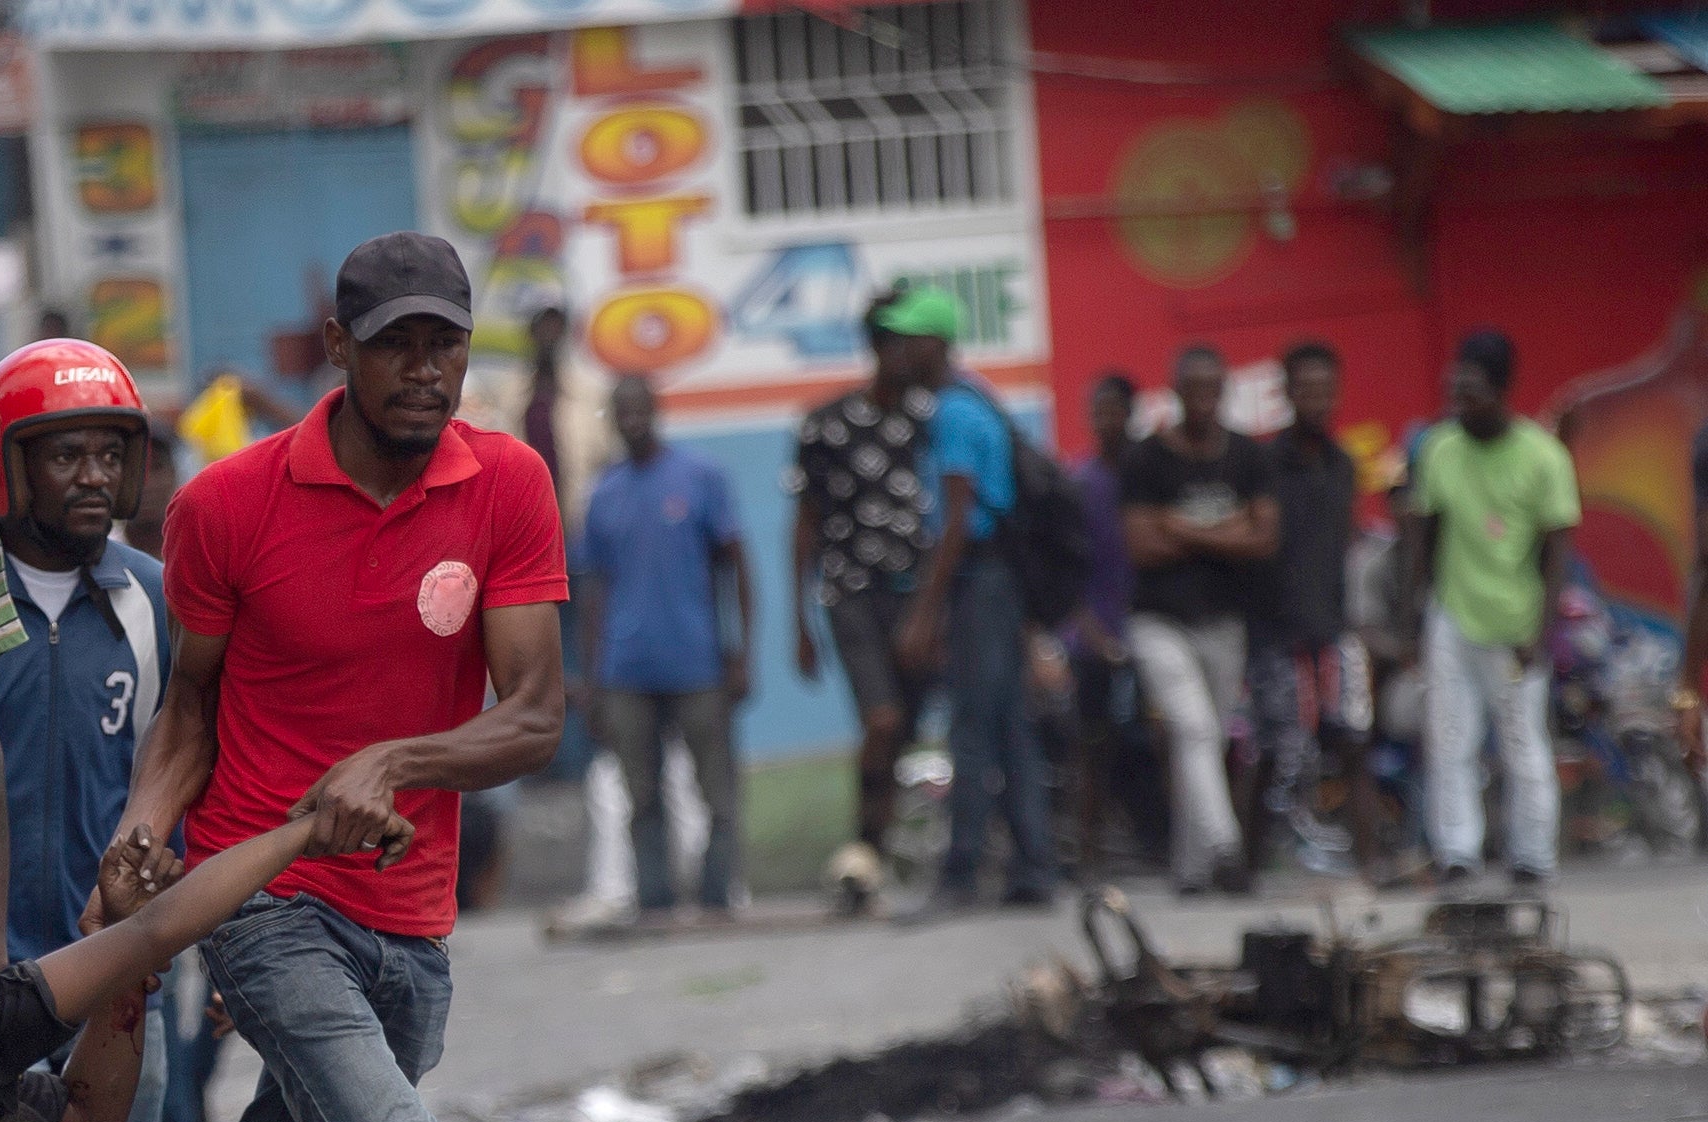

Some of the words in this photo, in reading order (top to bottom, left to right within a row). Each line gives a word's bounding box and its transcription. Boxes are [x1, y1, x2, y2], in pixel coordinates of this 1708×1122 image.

[570, 26, 722, 374] LOTO
[54, 366, 116, 386] LIFAN
[100, 671, 134, 735] 3
